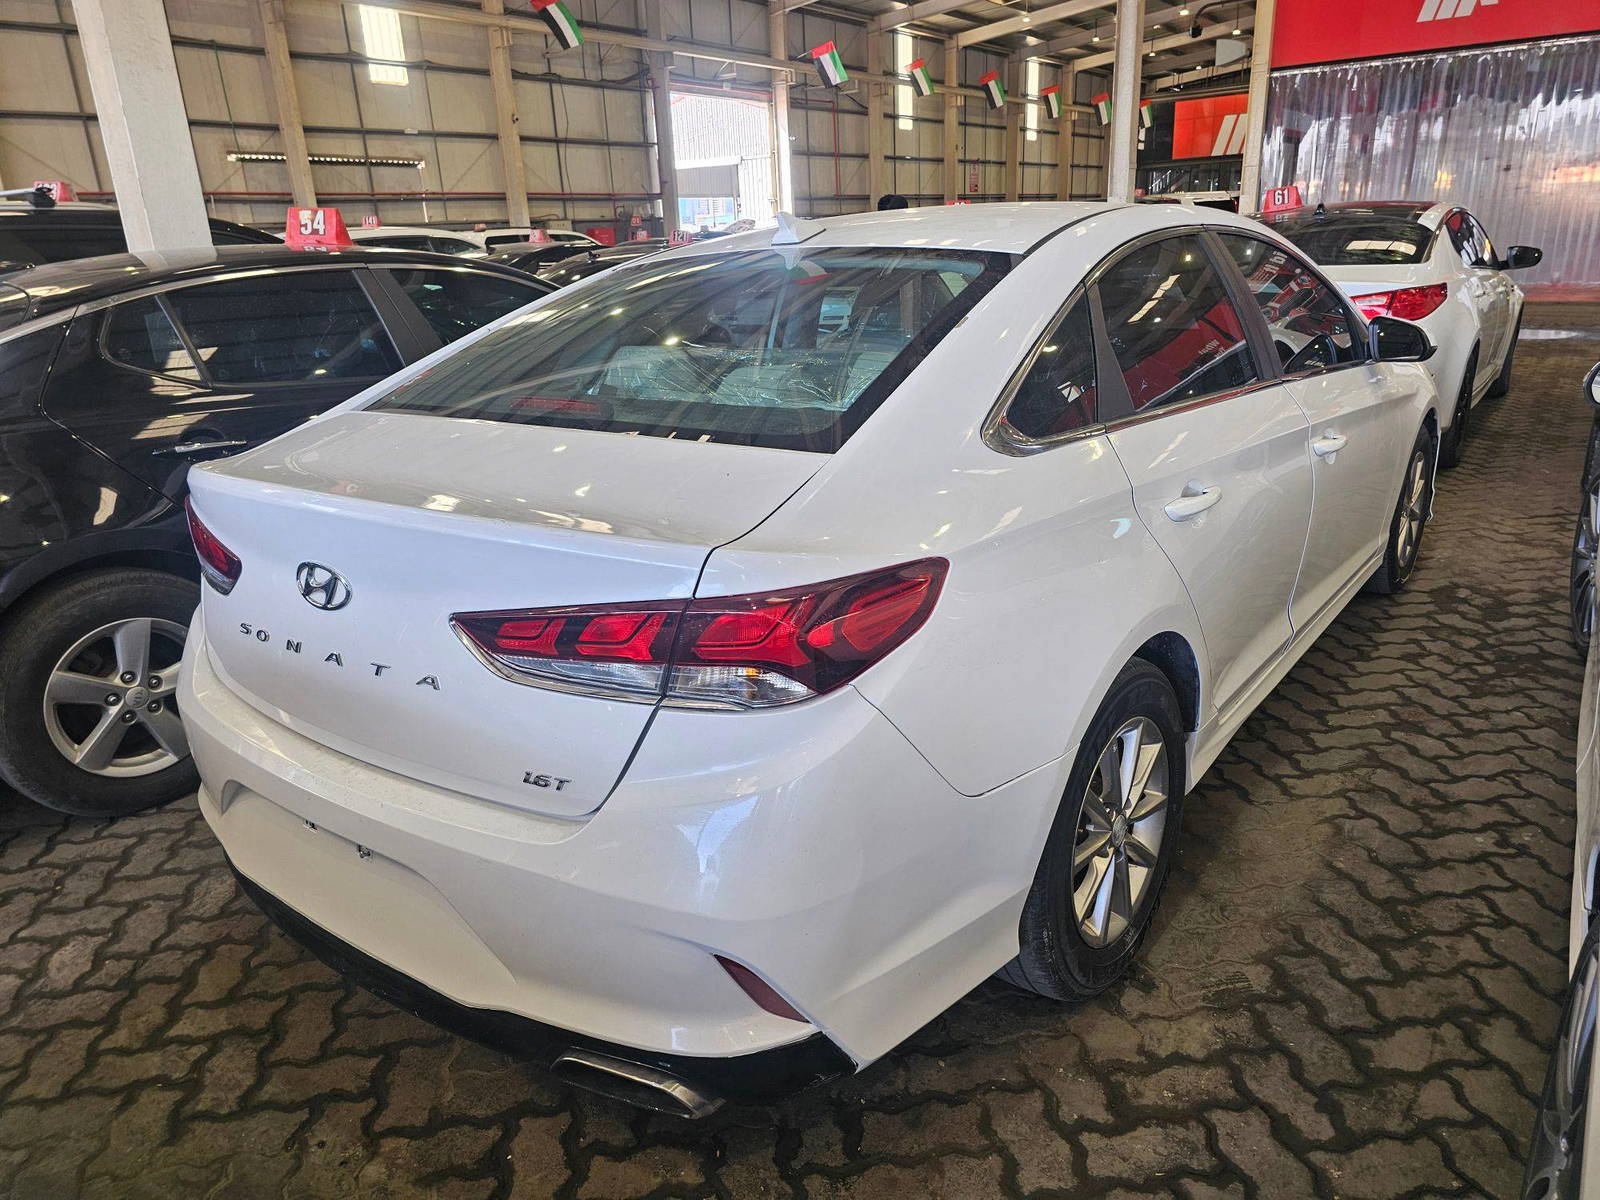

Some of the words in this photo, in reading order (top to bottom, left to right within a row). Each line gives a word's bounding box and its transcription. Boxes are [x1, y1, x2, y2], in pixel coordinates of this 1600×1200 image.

[1274, 188, 1289, 205] 61
[299, 209, 325, 235] 54
[239, 622, 440, 691] SONATA
